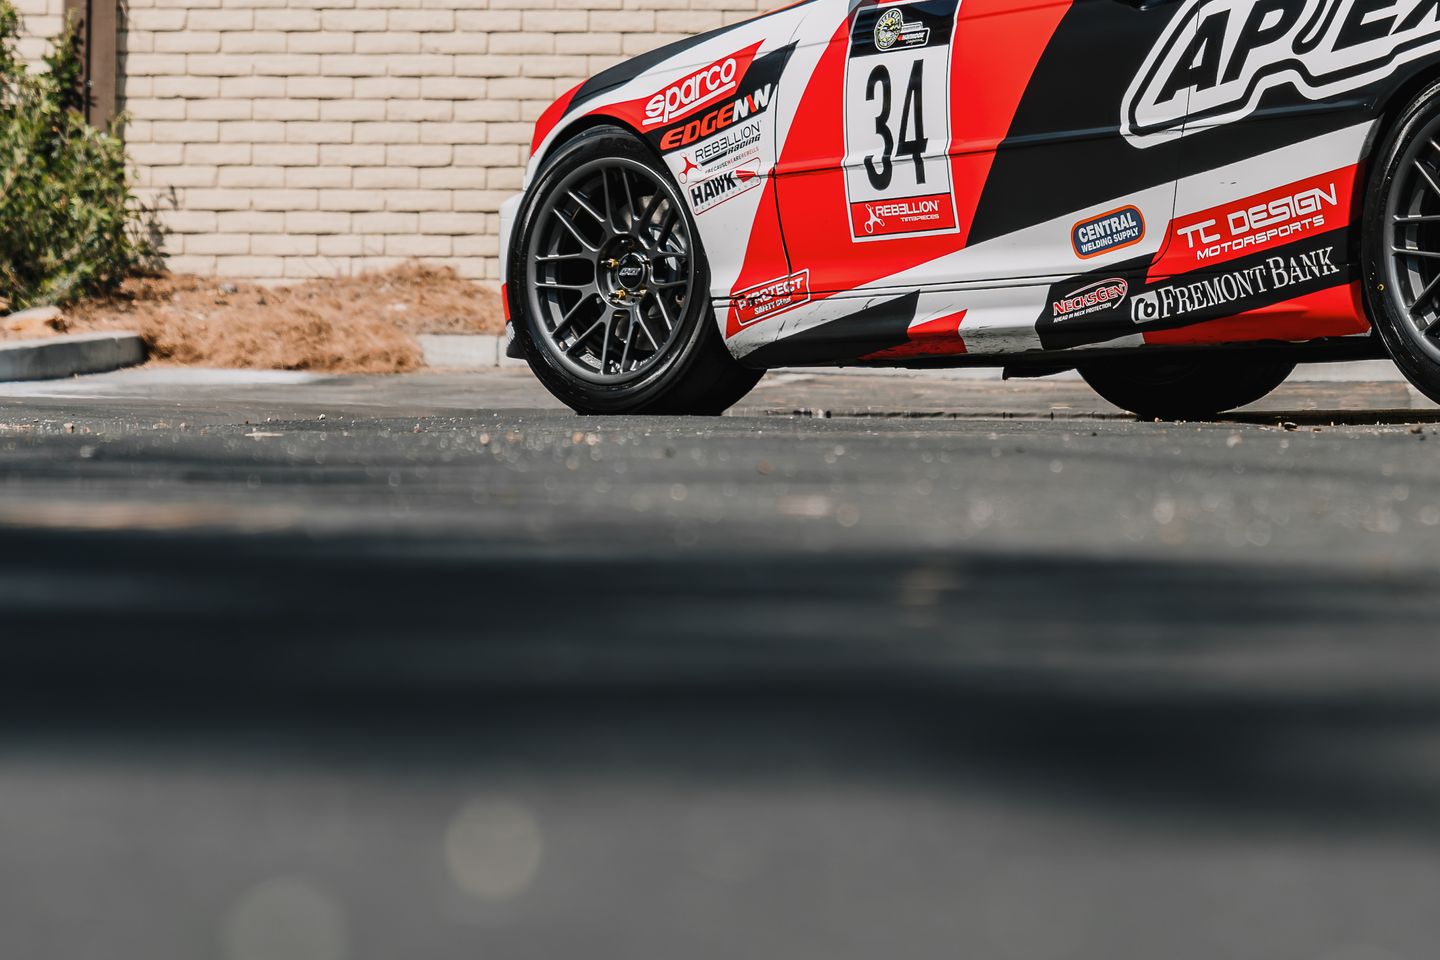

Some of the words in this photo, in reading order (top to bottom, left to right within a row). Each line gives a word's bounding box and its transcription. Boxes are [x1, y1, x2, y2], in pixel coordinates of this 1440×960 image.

[643, 58, 737, 123] sparco
[863, 59, 929, 190] 34
[691, 170, 737, 207] HAWK
[1176, 218, 1221, 248] TC
[1226, 183, 1338, 234] DESIGN
[1078, 212, 1137, 243] CENTRAL
[1080, 237, 1113, 253] WELDING
[1113, 227, 1139, 243] SUPPLY
[1197, 215, 1325, 260] MOTORSPORTS
[1158, 265, 1267, 319] FREMONT
[1266, 246, 1340, 290] BANK
